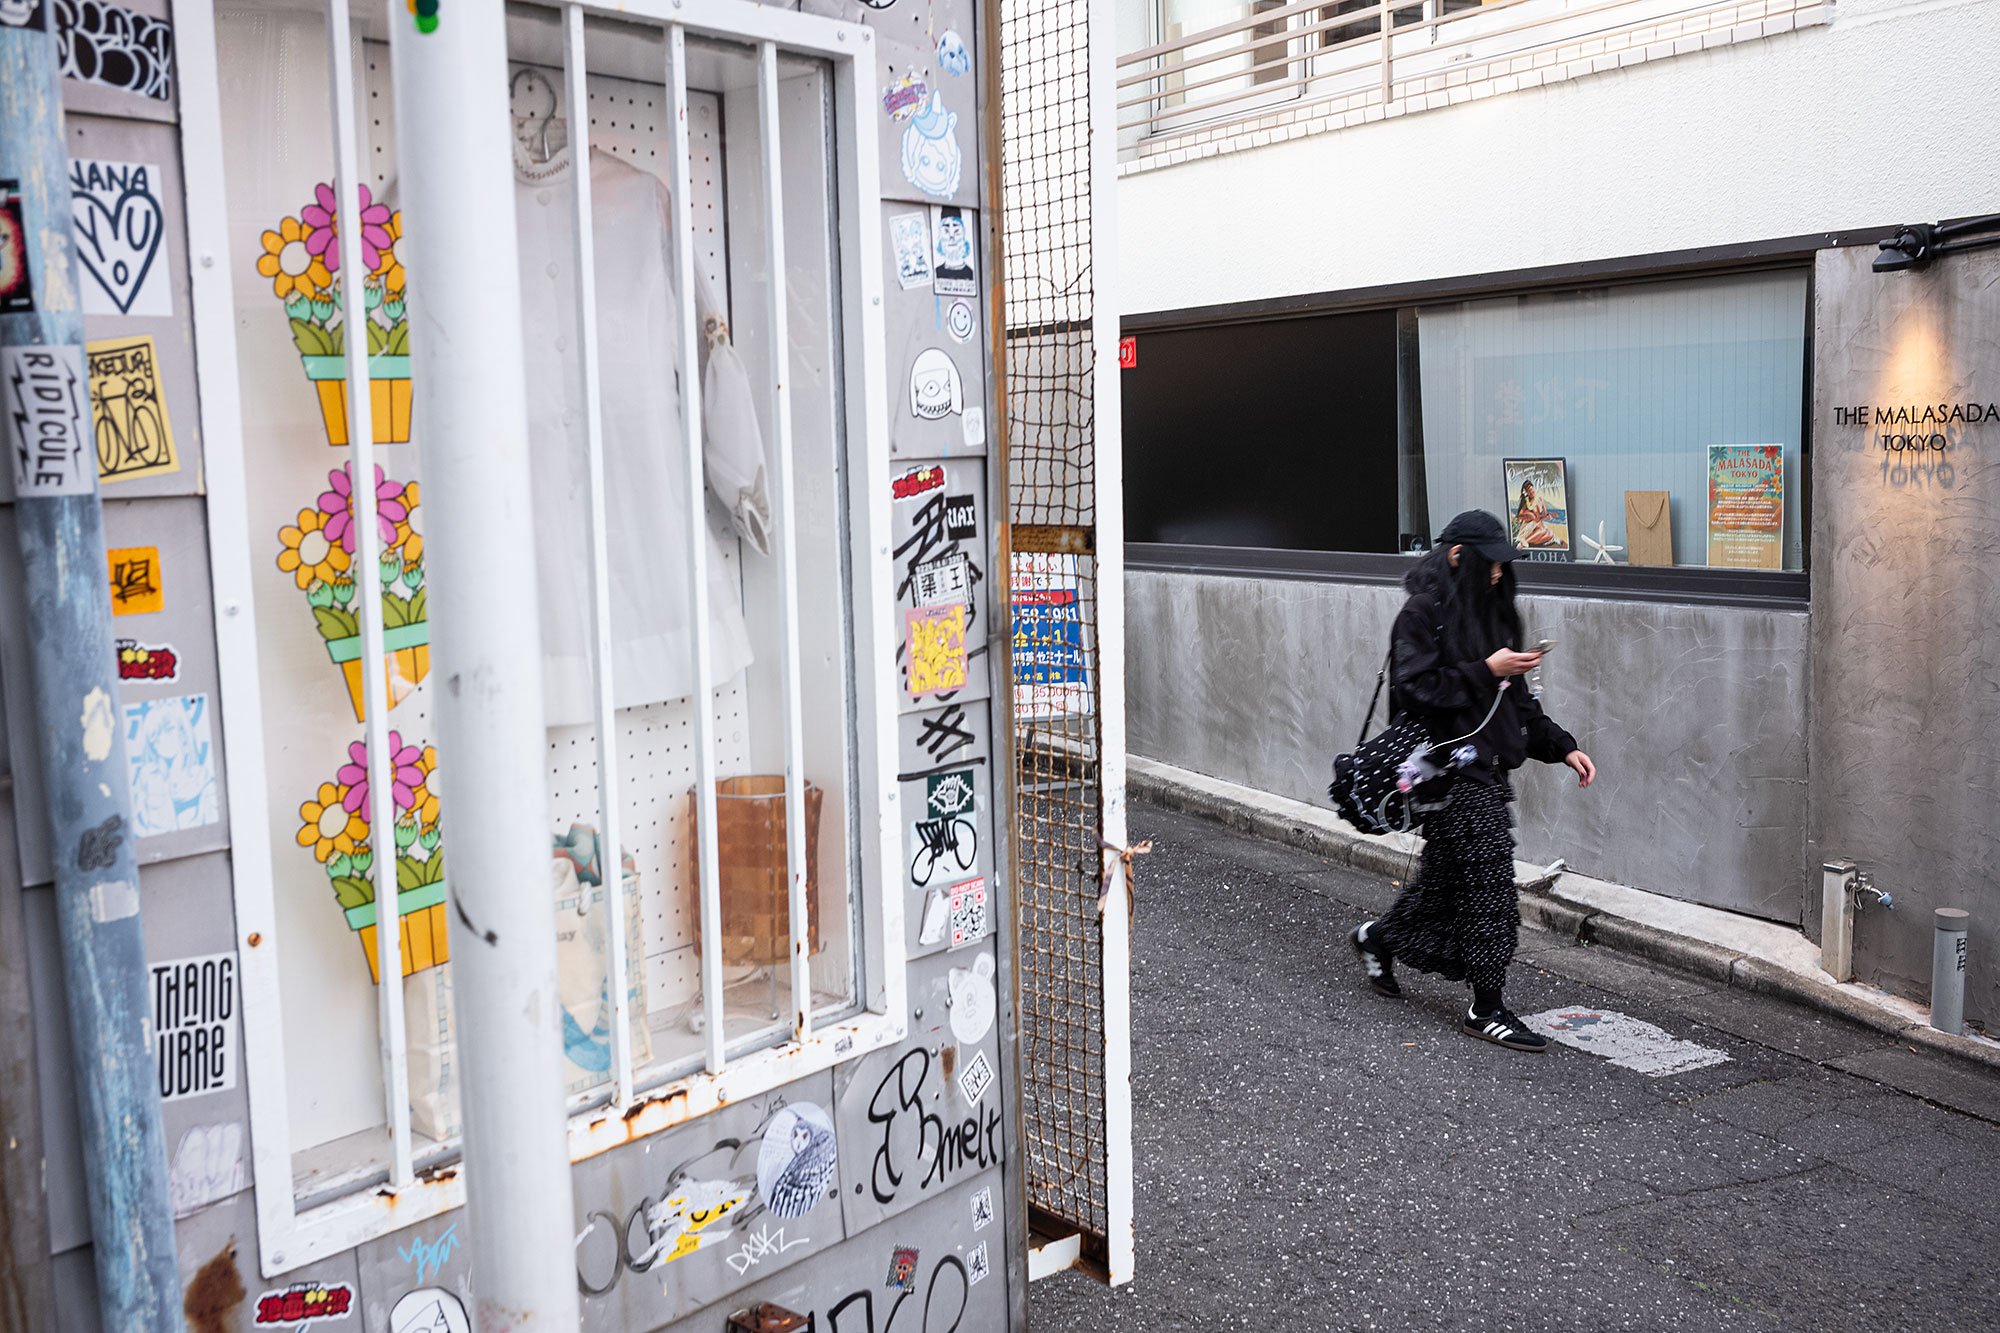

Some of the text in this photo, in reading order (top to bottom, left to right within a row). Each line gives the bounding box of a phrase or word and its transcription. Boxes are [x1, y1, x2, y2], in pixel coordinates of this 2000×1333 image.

[23, 353, 67, 487] RIDICULE
[1834, 403, 2000, 425] THE MALASADA
[1882, 434, 1947, 451] TOKYO
[1717, 458, 1772, 471] MALASADA
[1731, 470, 1758, 478] TOKYO
[1525, 551, 1568, 562] LOHA
